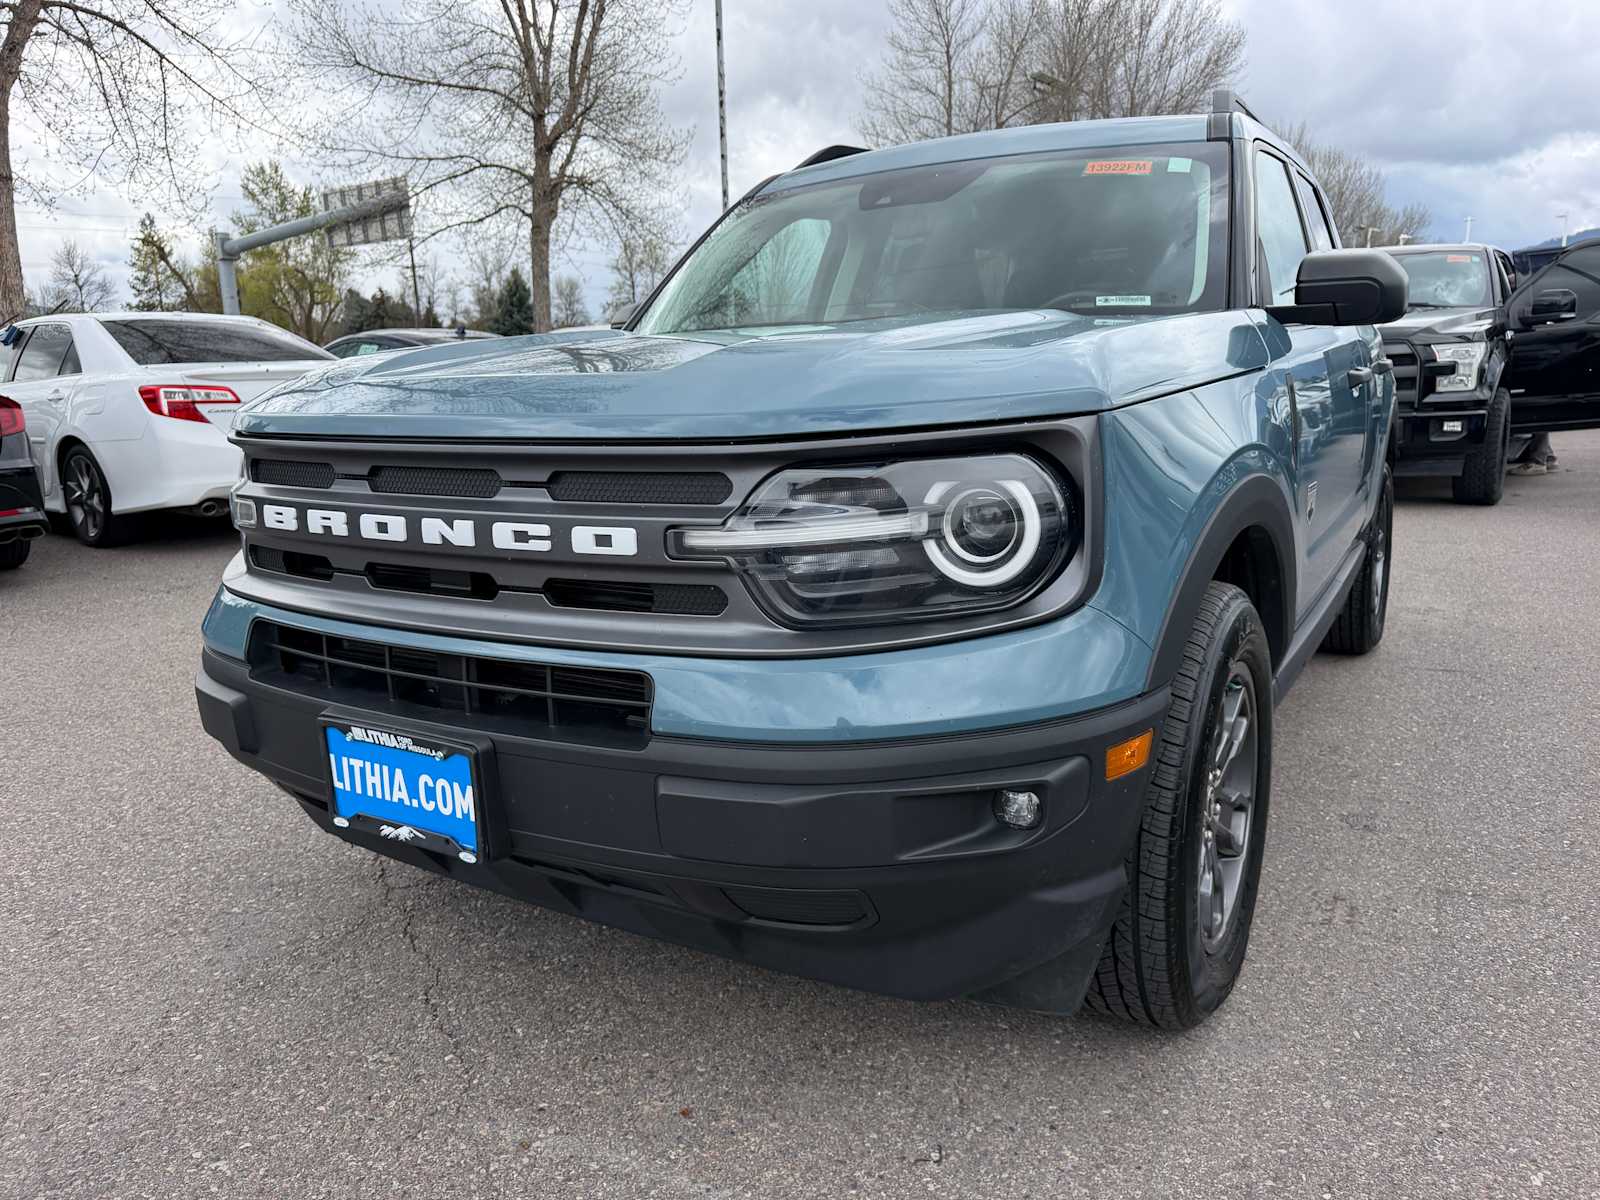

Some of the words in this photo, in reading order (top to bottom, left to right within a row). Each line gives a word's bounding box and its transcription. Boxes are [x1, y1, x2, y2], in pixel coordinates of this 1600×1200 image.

[263, 503, 638, 556] BRONCO
[361, 728, 400, 749] LITHIA
[330, 753, 476, 822] LITHIA.COM
